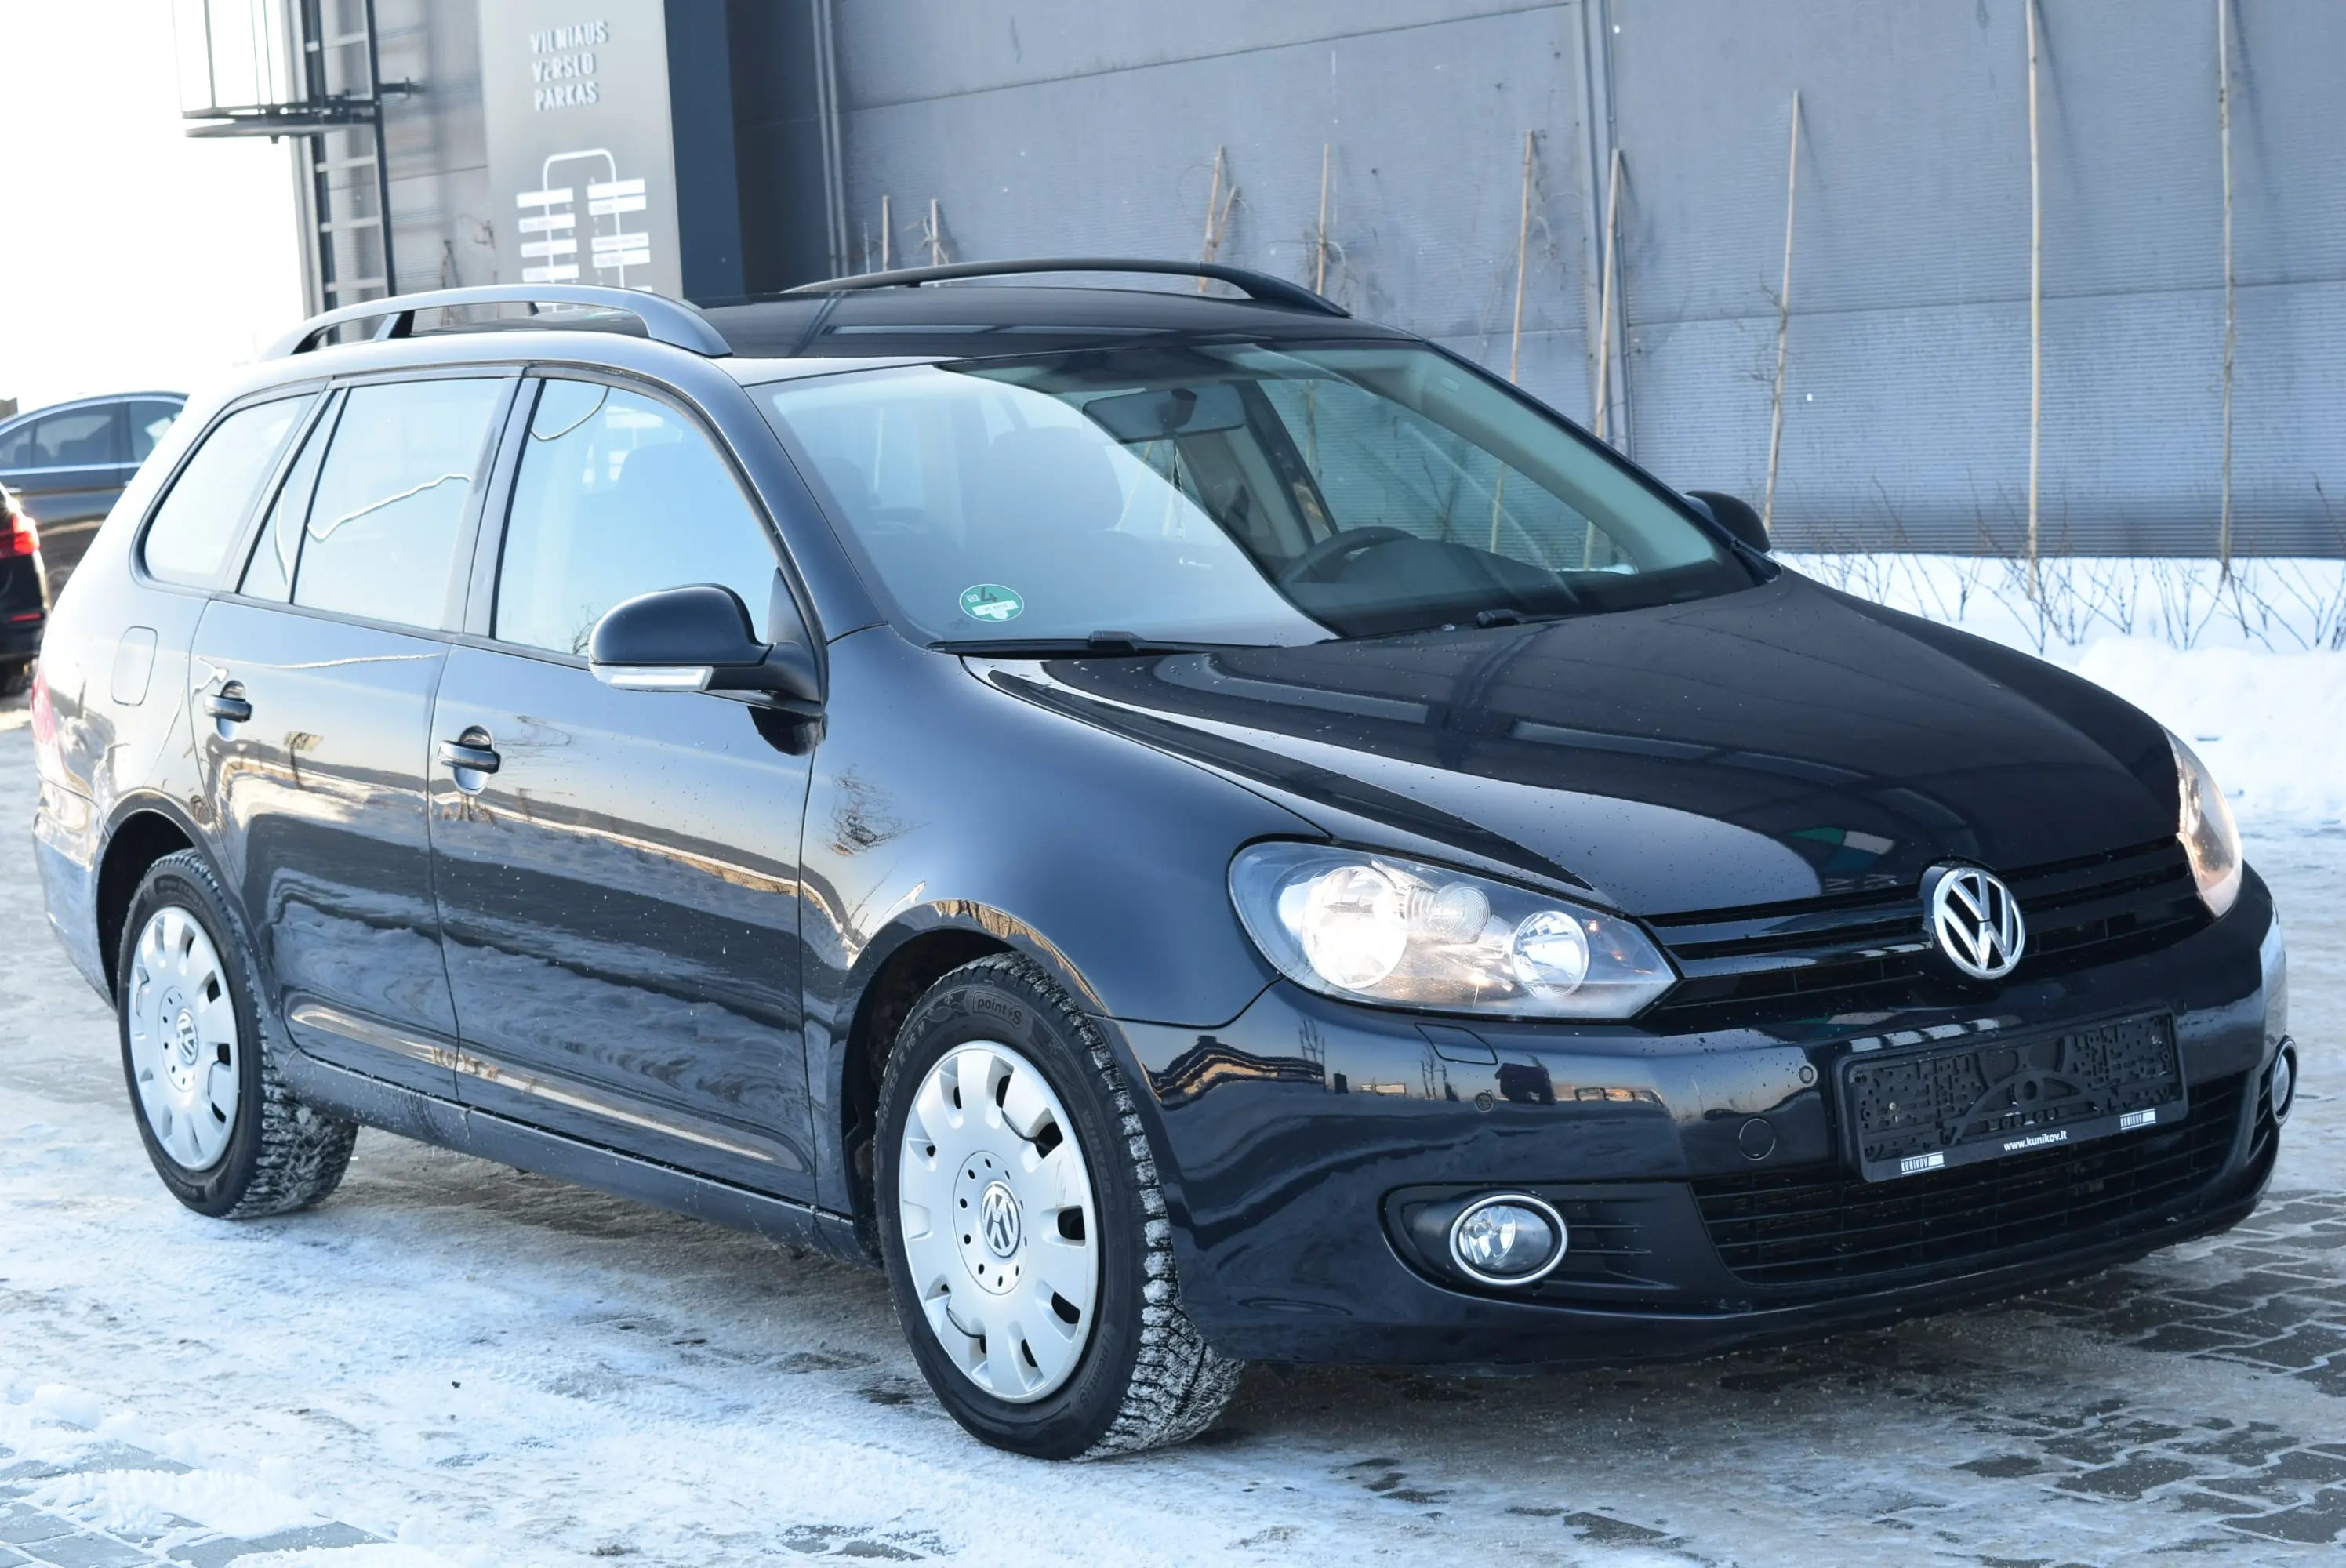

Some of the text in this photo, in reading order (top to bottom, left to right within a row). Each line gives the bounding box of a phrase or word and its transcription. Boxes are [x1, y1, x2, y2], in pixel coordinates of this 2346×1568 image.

[530, 20, 609, 54] VILNIAUS
[532, 51, 596, 83] VERSLO
[533, 81, 599, 111] PARKAS
[1933, 867, 2025, 979] VW
[977, 997, 1007, 1014] point
[2003, 1130, 2067, 1151] www.kunikov.lt
[1901, 1156, 1927, 1172] KUNIKOV
[981, 1181, 1021, 1258] VW
